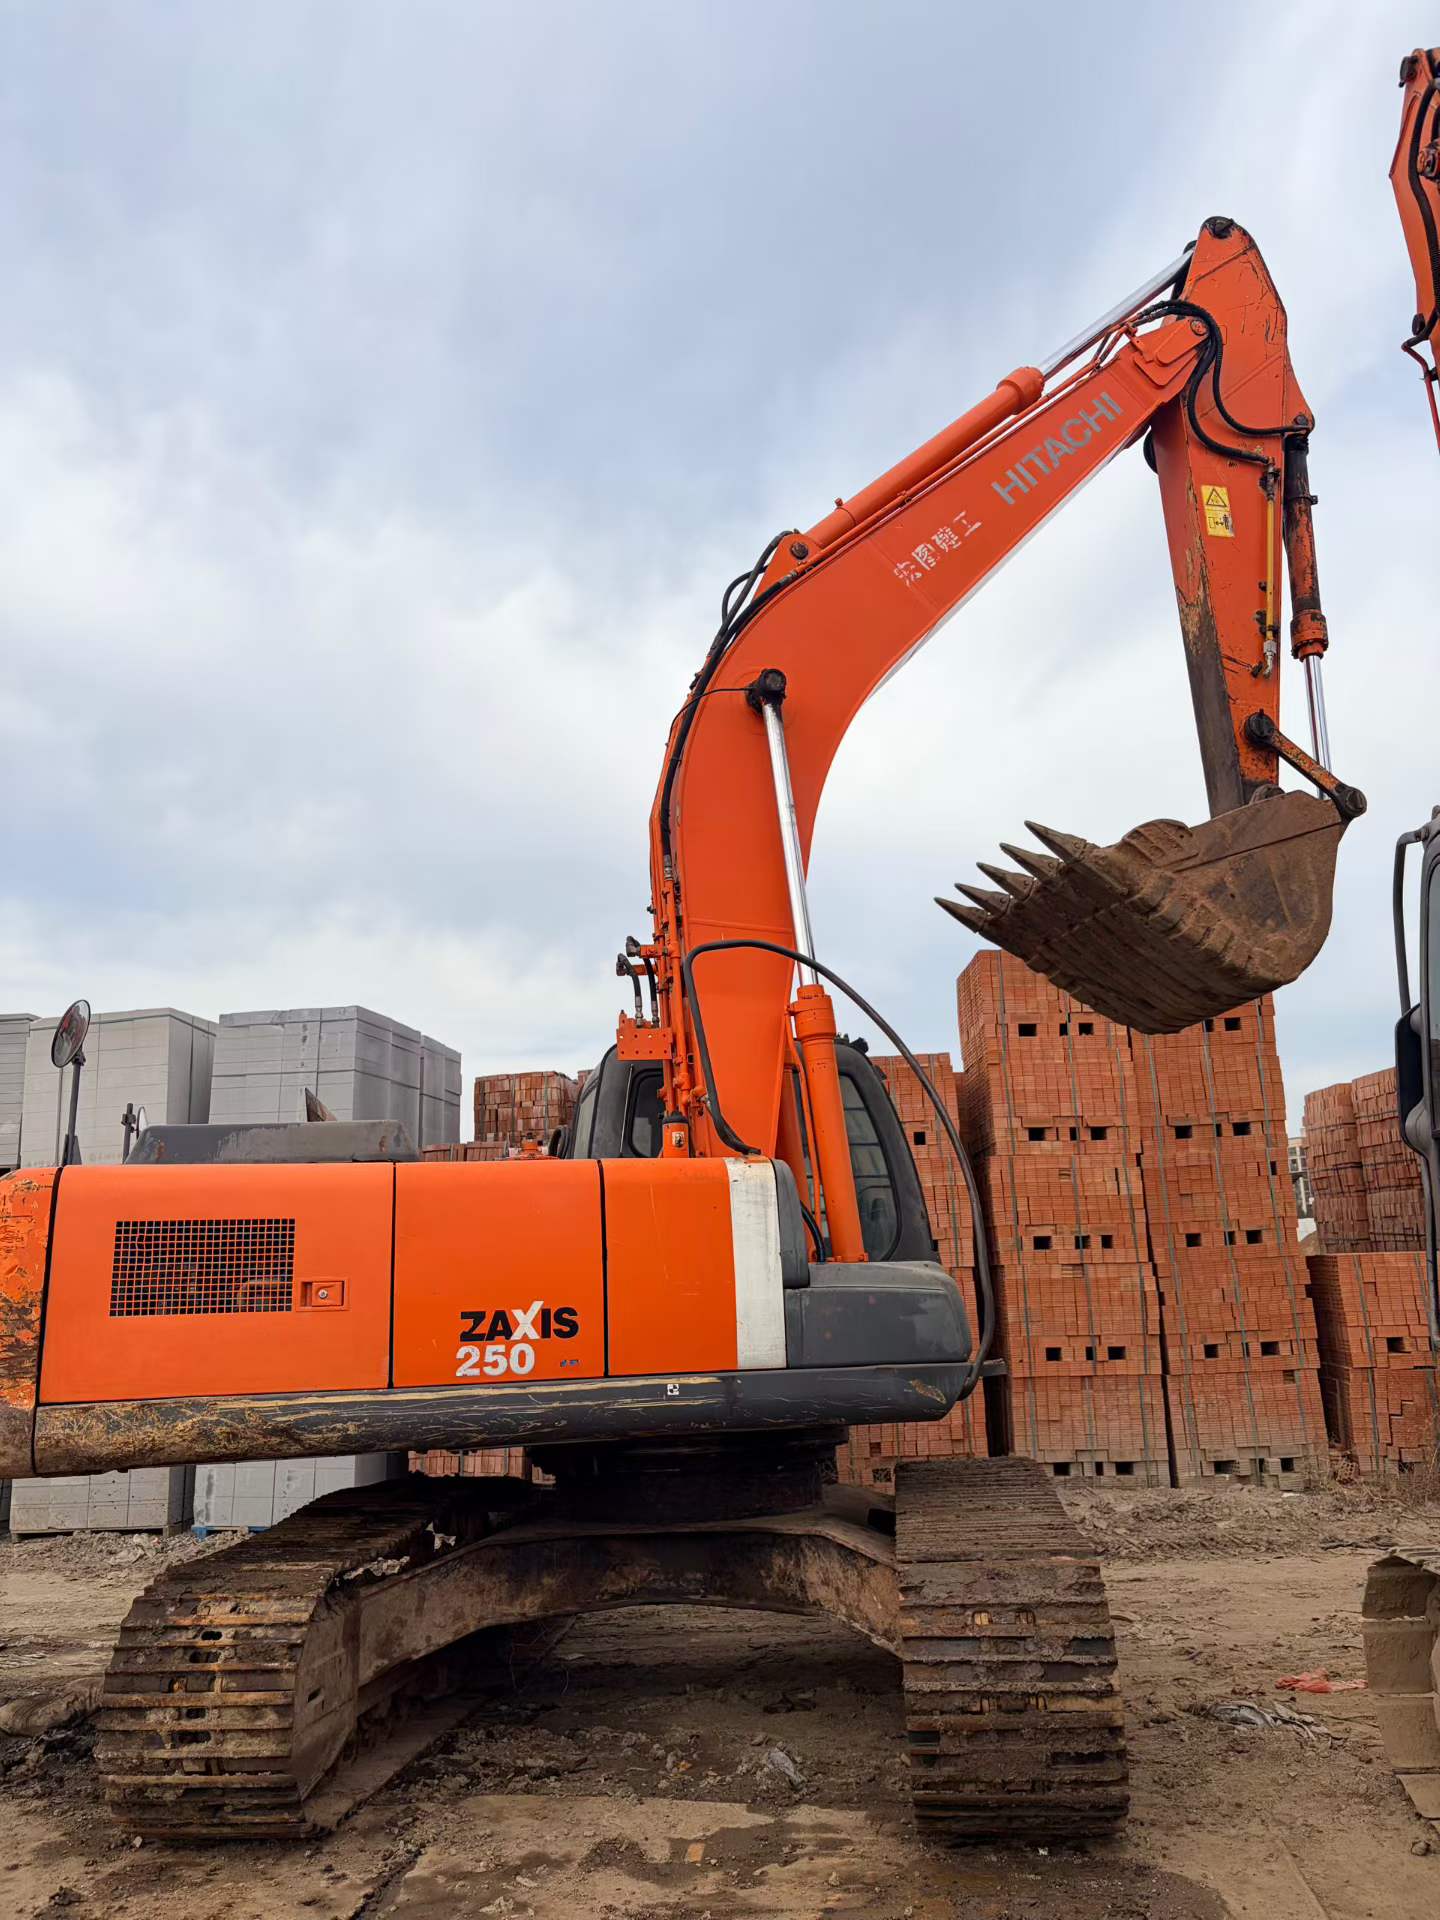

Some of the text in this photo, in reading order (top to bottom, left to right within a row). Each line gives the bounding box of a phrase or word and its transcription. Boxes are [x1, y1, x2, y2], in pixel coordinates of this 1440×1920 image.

[991, 391, 1124, 505] HITACHI
[459, 1300, 580, 1342] ZAXIS
[455, 1342, 535, 1377] 250
